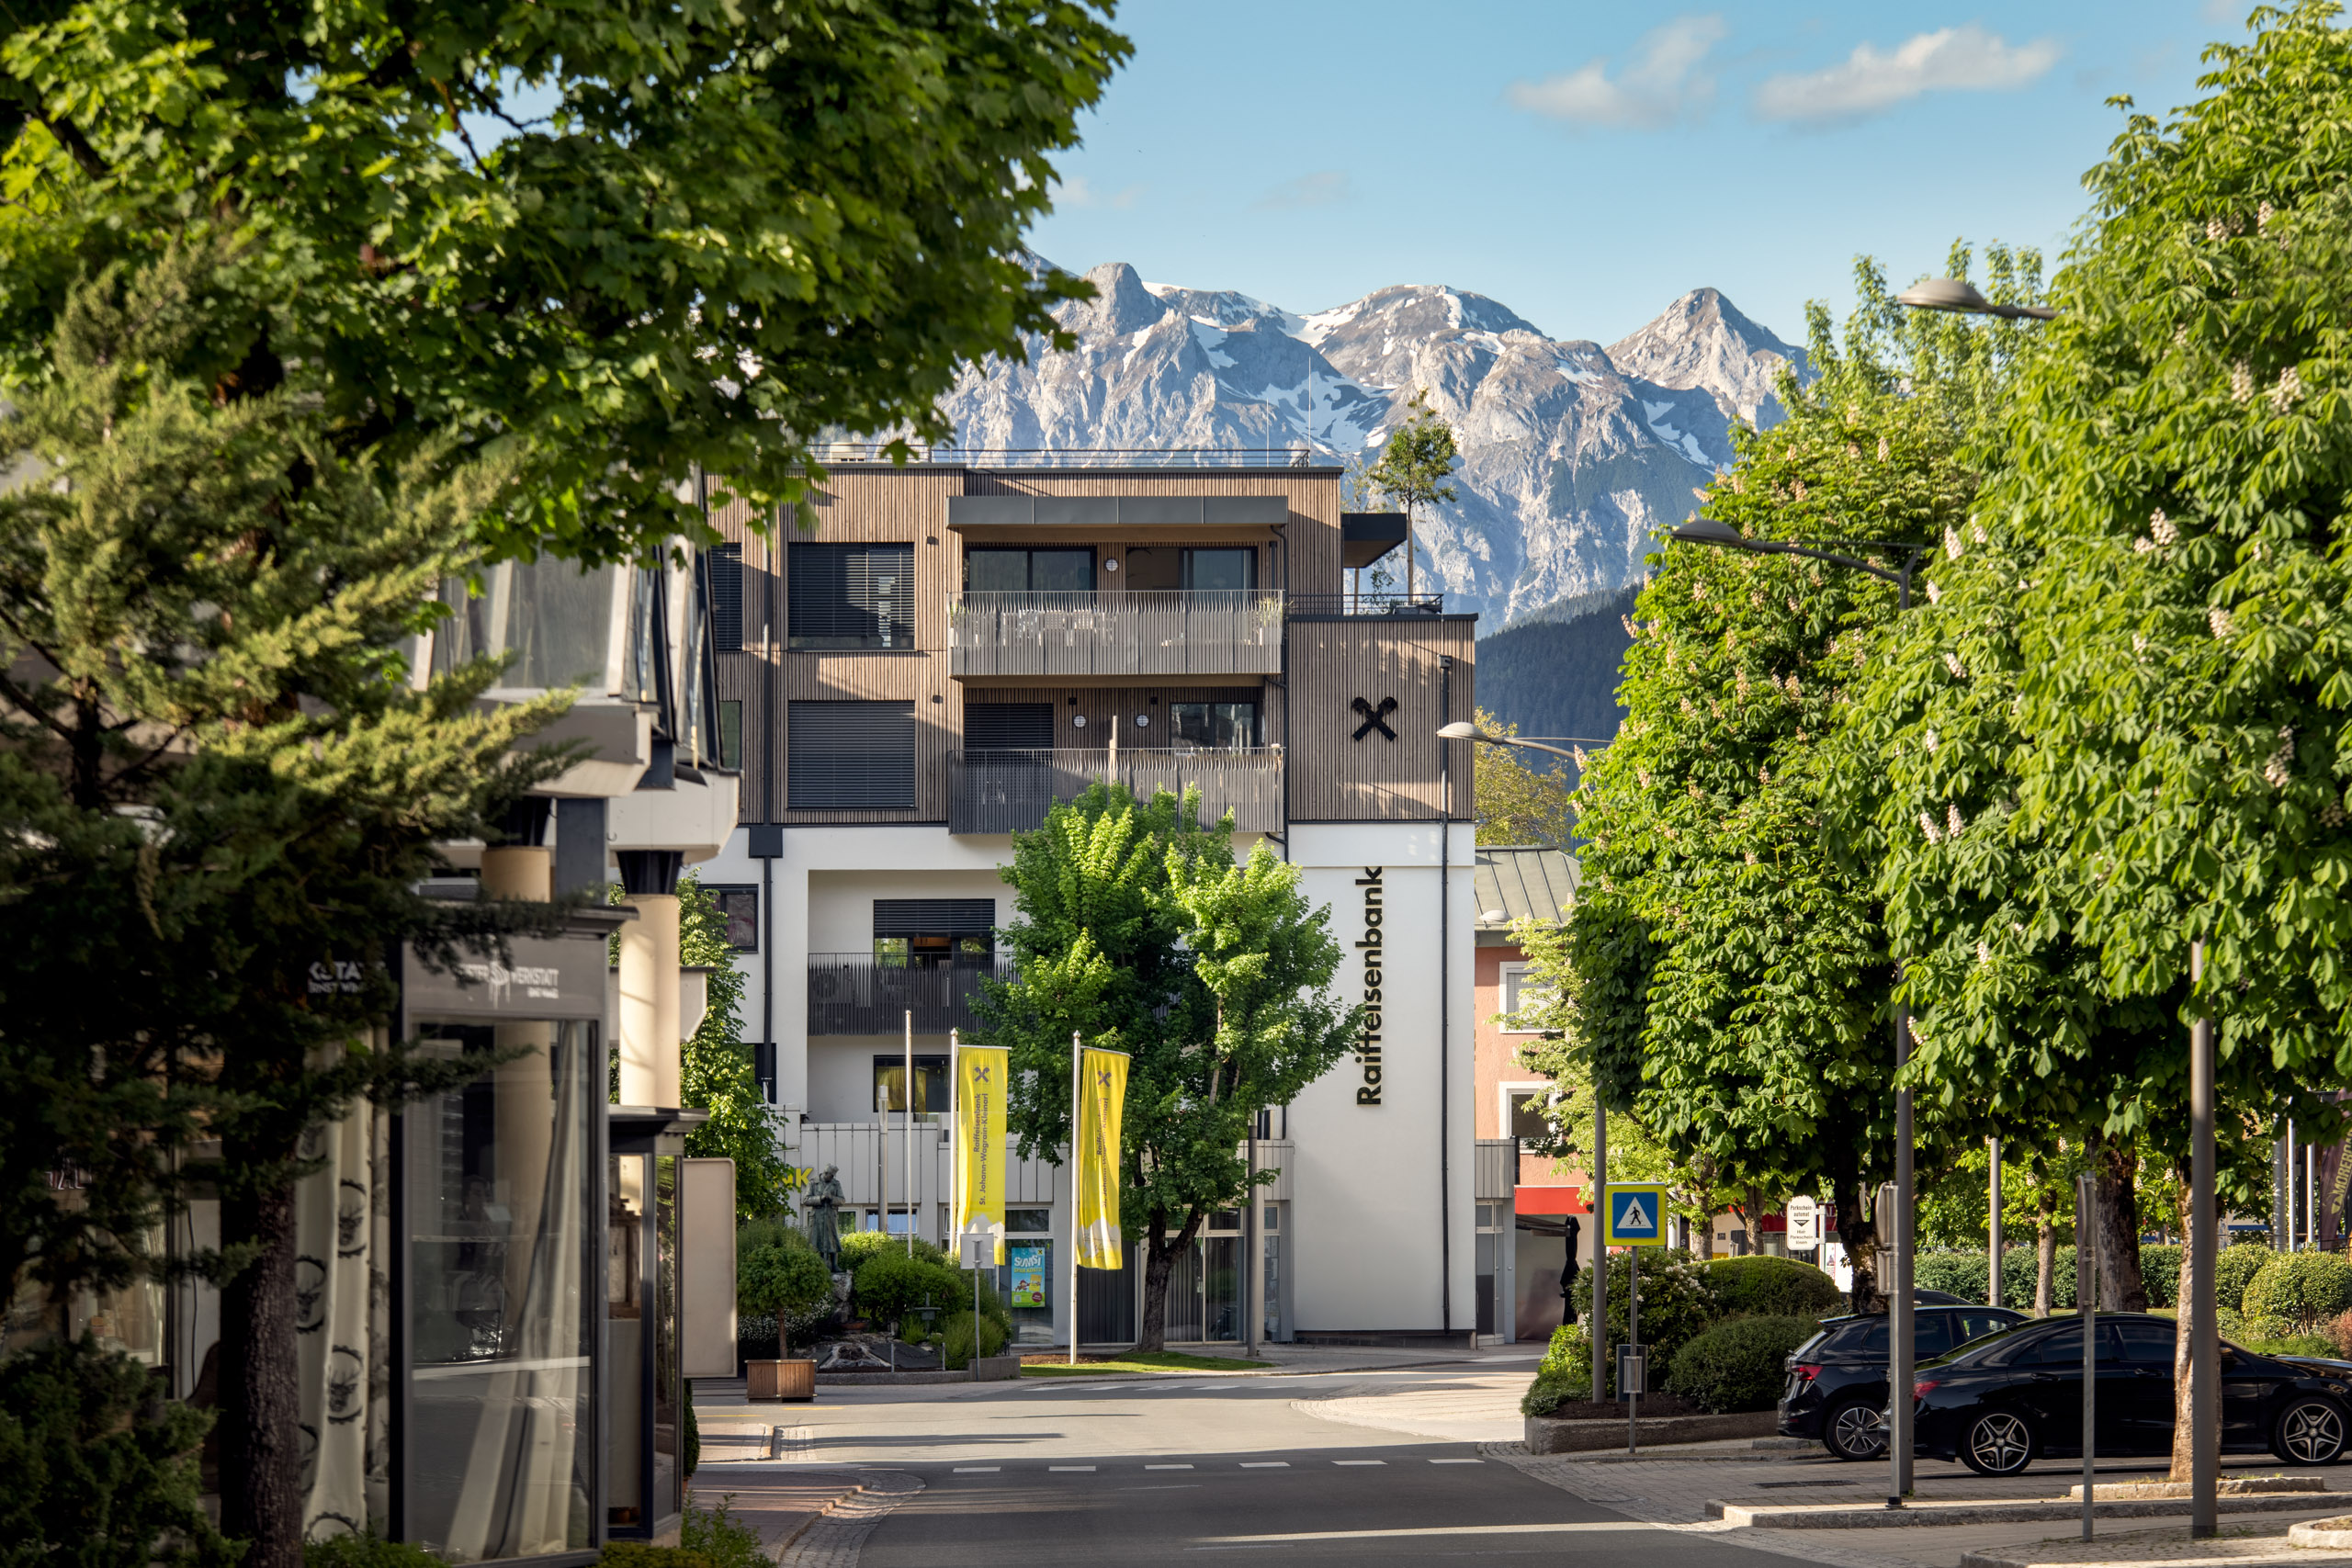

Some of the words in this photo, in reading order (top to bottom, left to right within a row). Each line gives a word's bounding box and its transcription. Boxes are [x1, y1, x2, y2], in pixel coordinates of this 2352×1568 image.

[1355, 866, 1383, 1106] Raiffeisenbank
[973, 1093, 981, 1153] Raiffeisenbank
[979, 1093, 989, 1193] Johann-Wagrain-Kleinarl
[1013, 1255, 1041, 1268] SUMSI
